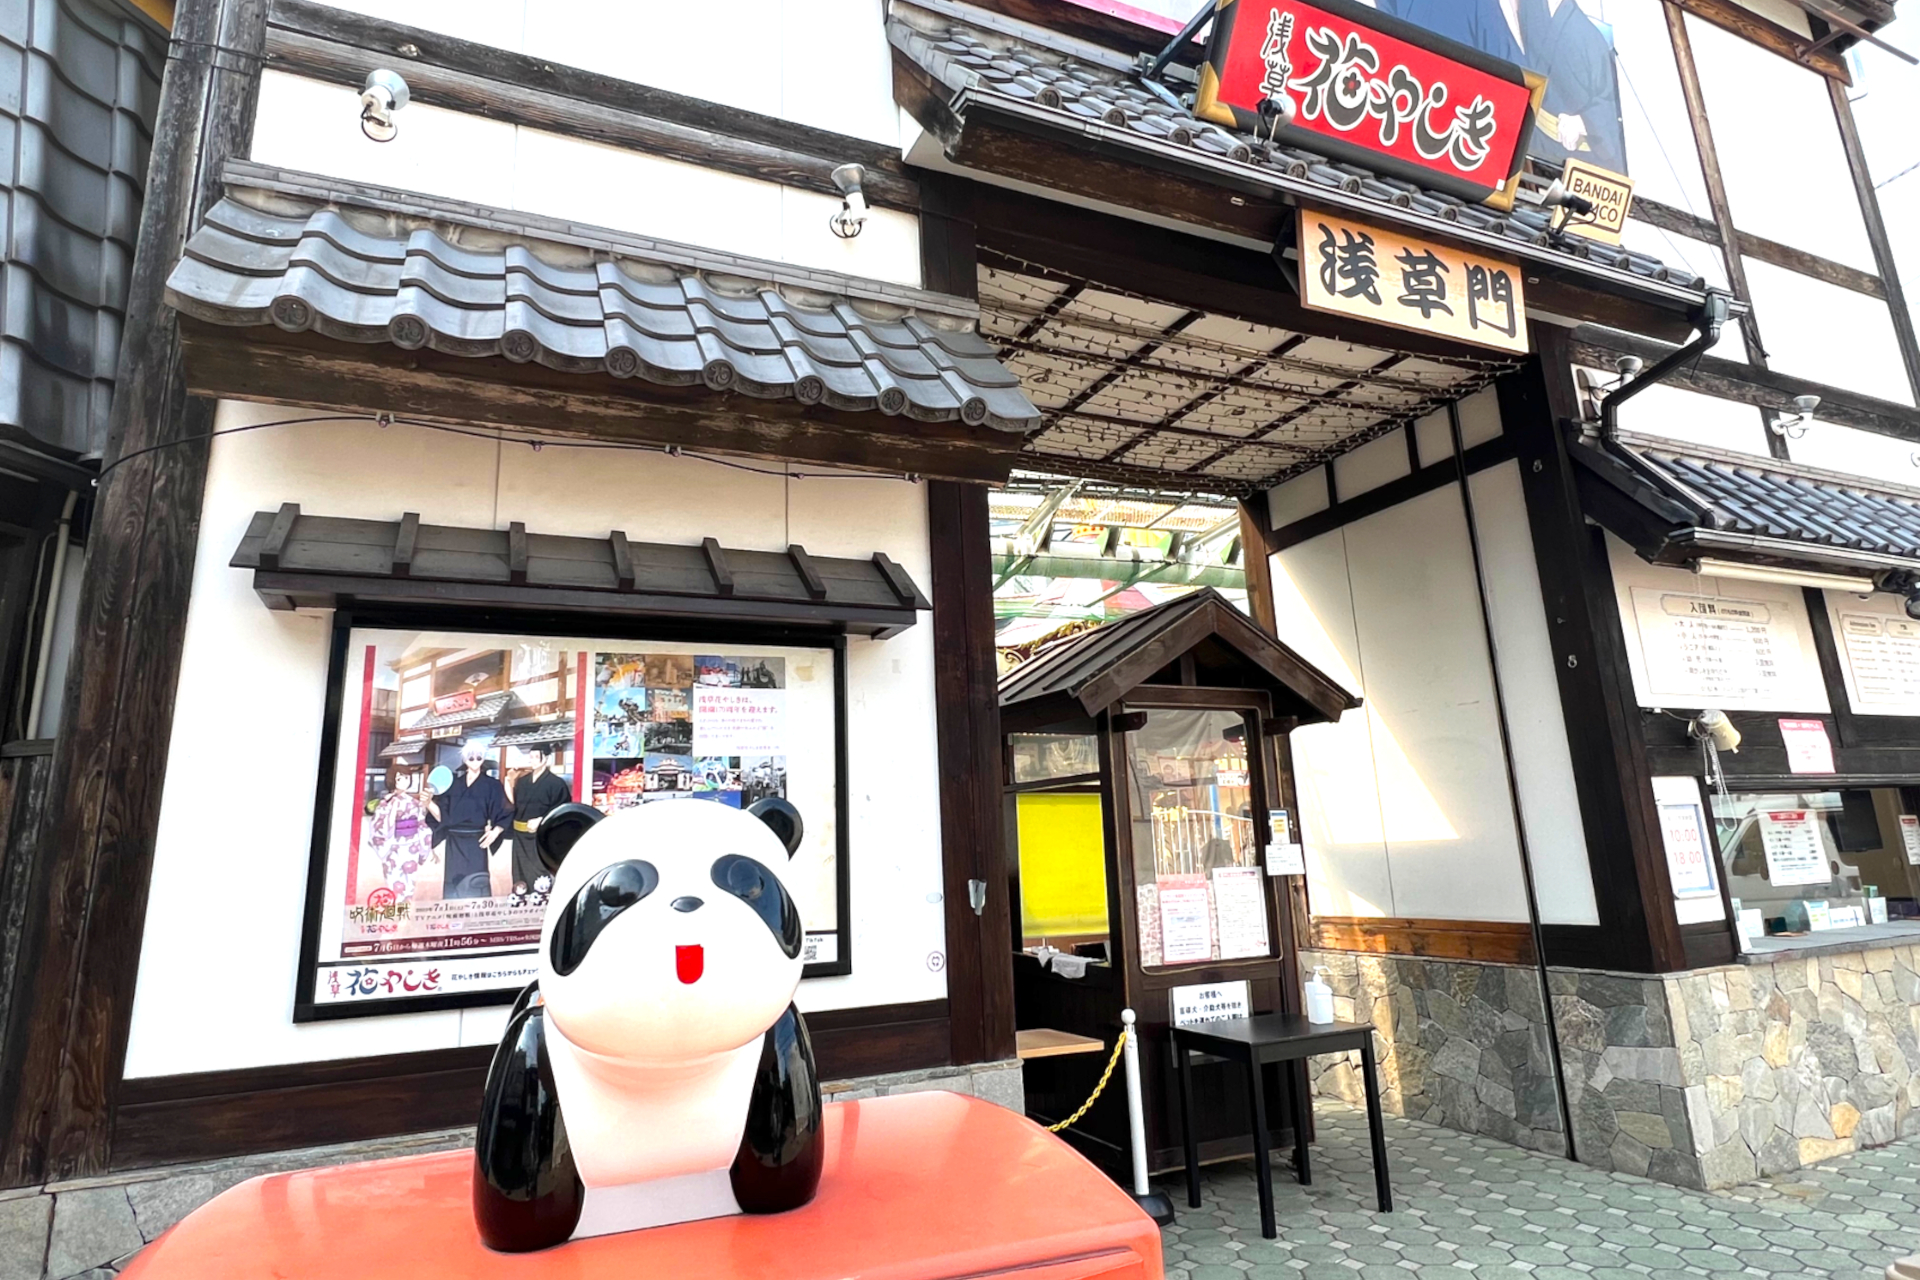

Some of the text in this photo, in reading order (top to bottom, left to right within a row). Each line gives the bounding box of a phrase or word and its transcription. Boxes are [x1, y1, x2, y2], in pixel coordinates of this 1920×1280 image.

[1260, 9, 1295, 99] 浅草
[1290, 28, 1496, 170] 花やしき
[1573, 177, 1624, 207] BANDAI
[1318, 222, 1517, 339] 浅草門
[345, 967, 441, 996] 花やしき
